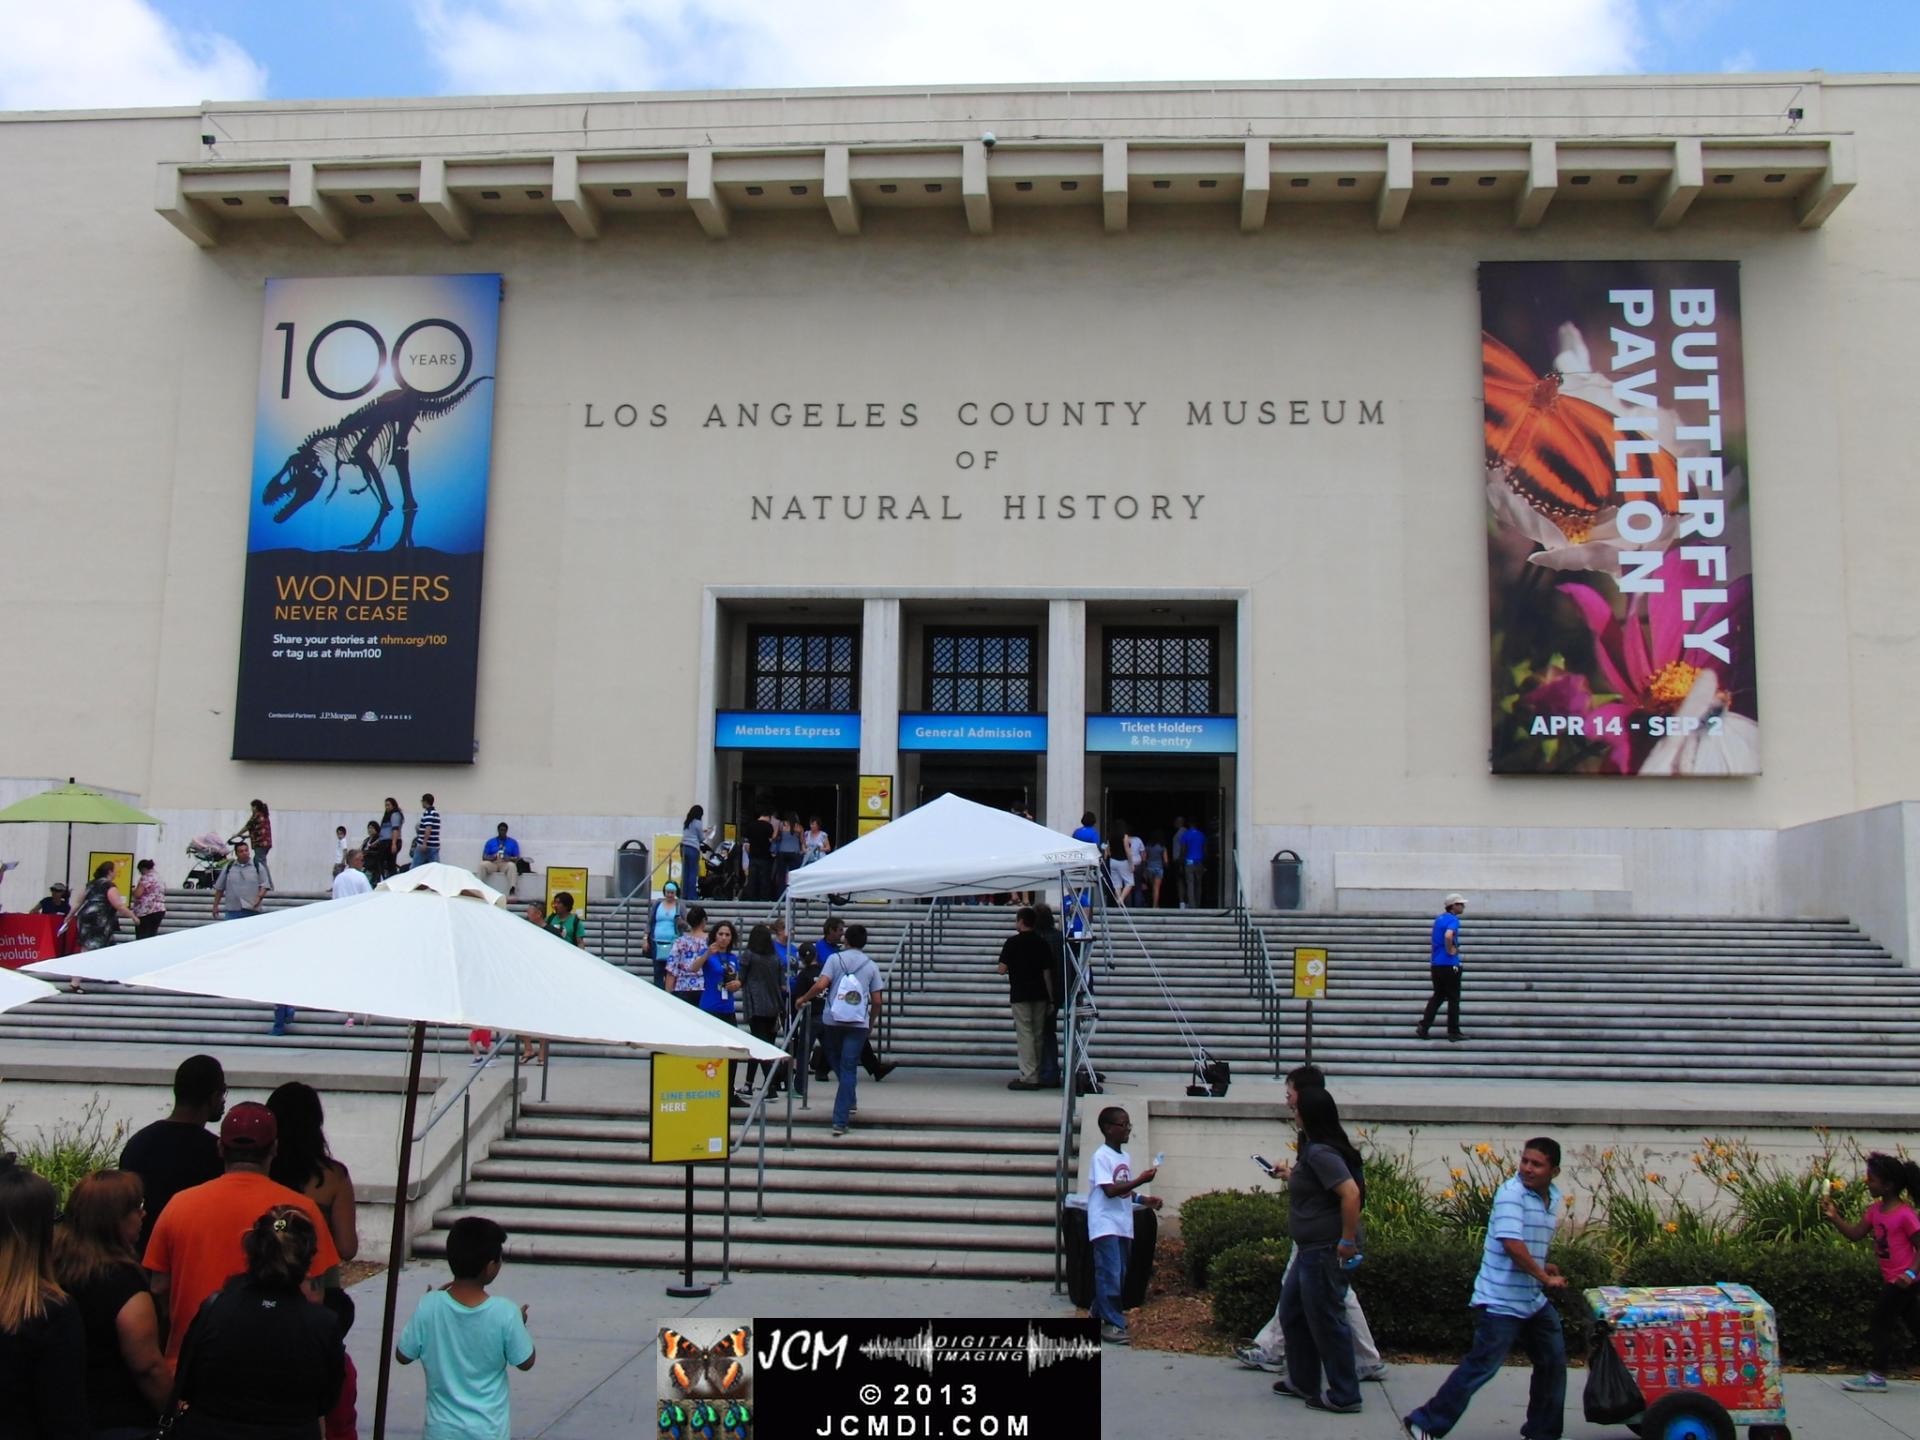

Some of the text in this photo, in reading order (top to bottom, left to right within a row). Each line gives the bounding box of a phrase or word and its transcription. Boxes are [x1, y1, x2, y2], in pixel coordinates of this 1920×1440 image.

[275, 318, 473, 401] 100
[409, 353, 457, 366] YEARS
[584, 400, 1385, 428] LOS ANGELES COUNTY MUSEUM
[1609, 288, 1665, 593] PAVILION
[956, 450, 998, 470] OF
[1669, 288, 1732, 665] BUTTERFLY
[750, 495, 1205, 520] NATURAL HISTORY
[276, 575, 450, 602] WONDERS
[275, 605, 408, 621] NEVER CEASE
[273, 633, 448, 647] Share your stories at nhm.org/100
[272, 648, 382, 660] or tag us at #nhm100
[735, 724, 841, 738] Members Express
[915, 726, 1032, 739] General Admission
[1120, 722, 1203, 733] Ticket Holders
[1530, 715, 1585, 736] APR
[1593, 716, 1623, 736] 14
[1648, 715, 1700, 736] SEP
[1707, 716, 1723, 736] 2
[1131, 736, 1193, 748] & Re-entry
[17, 933, 36, 945] the
[661, 1089, 720, 1101] LINE BEGINS
[660, 1103, 687, 1113] HERE
